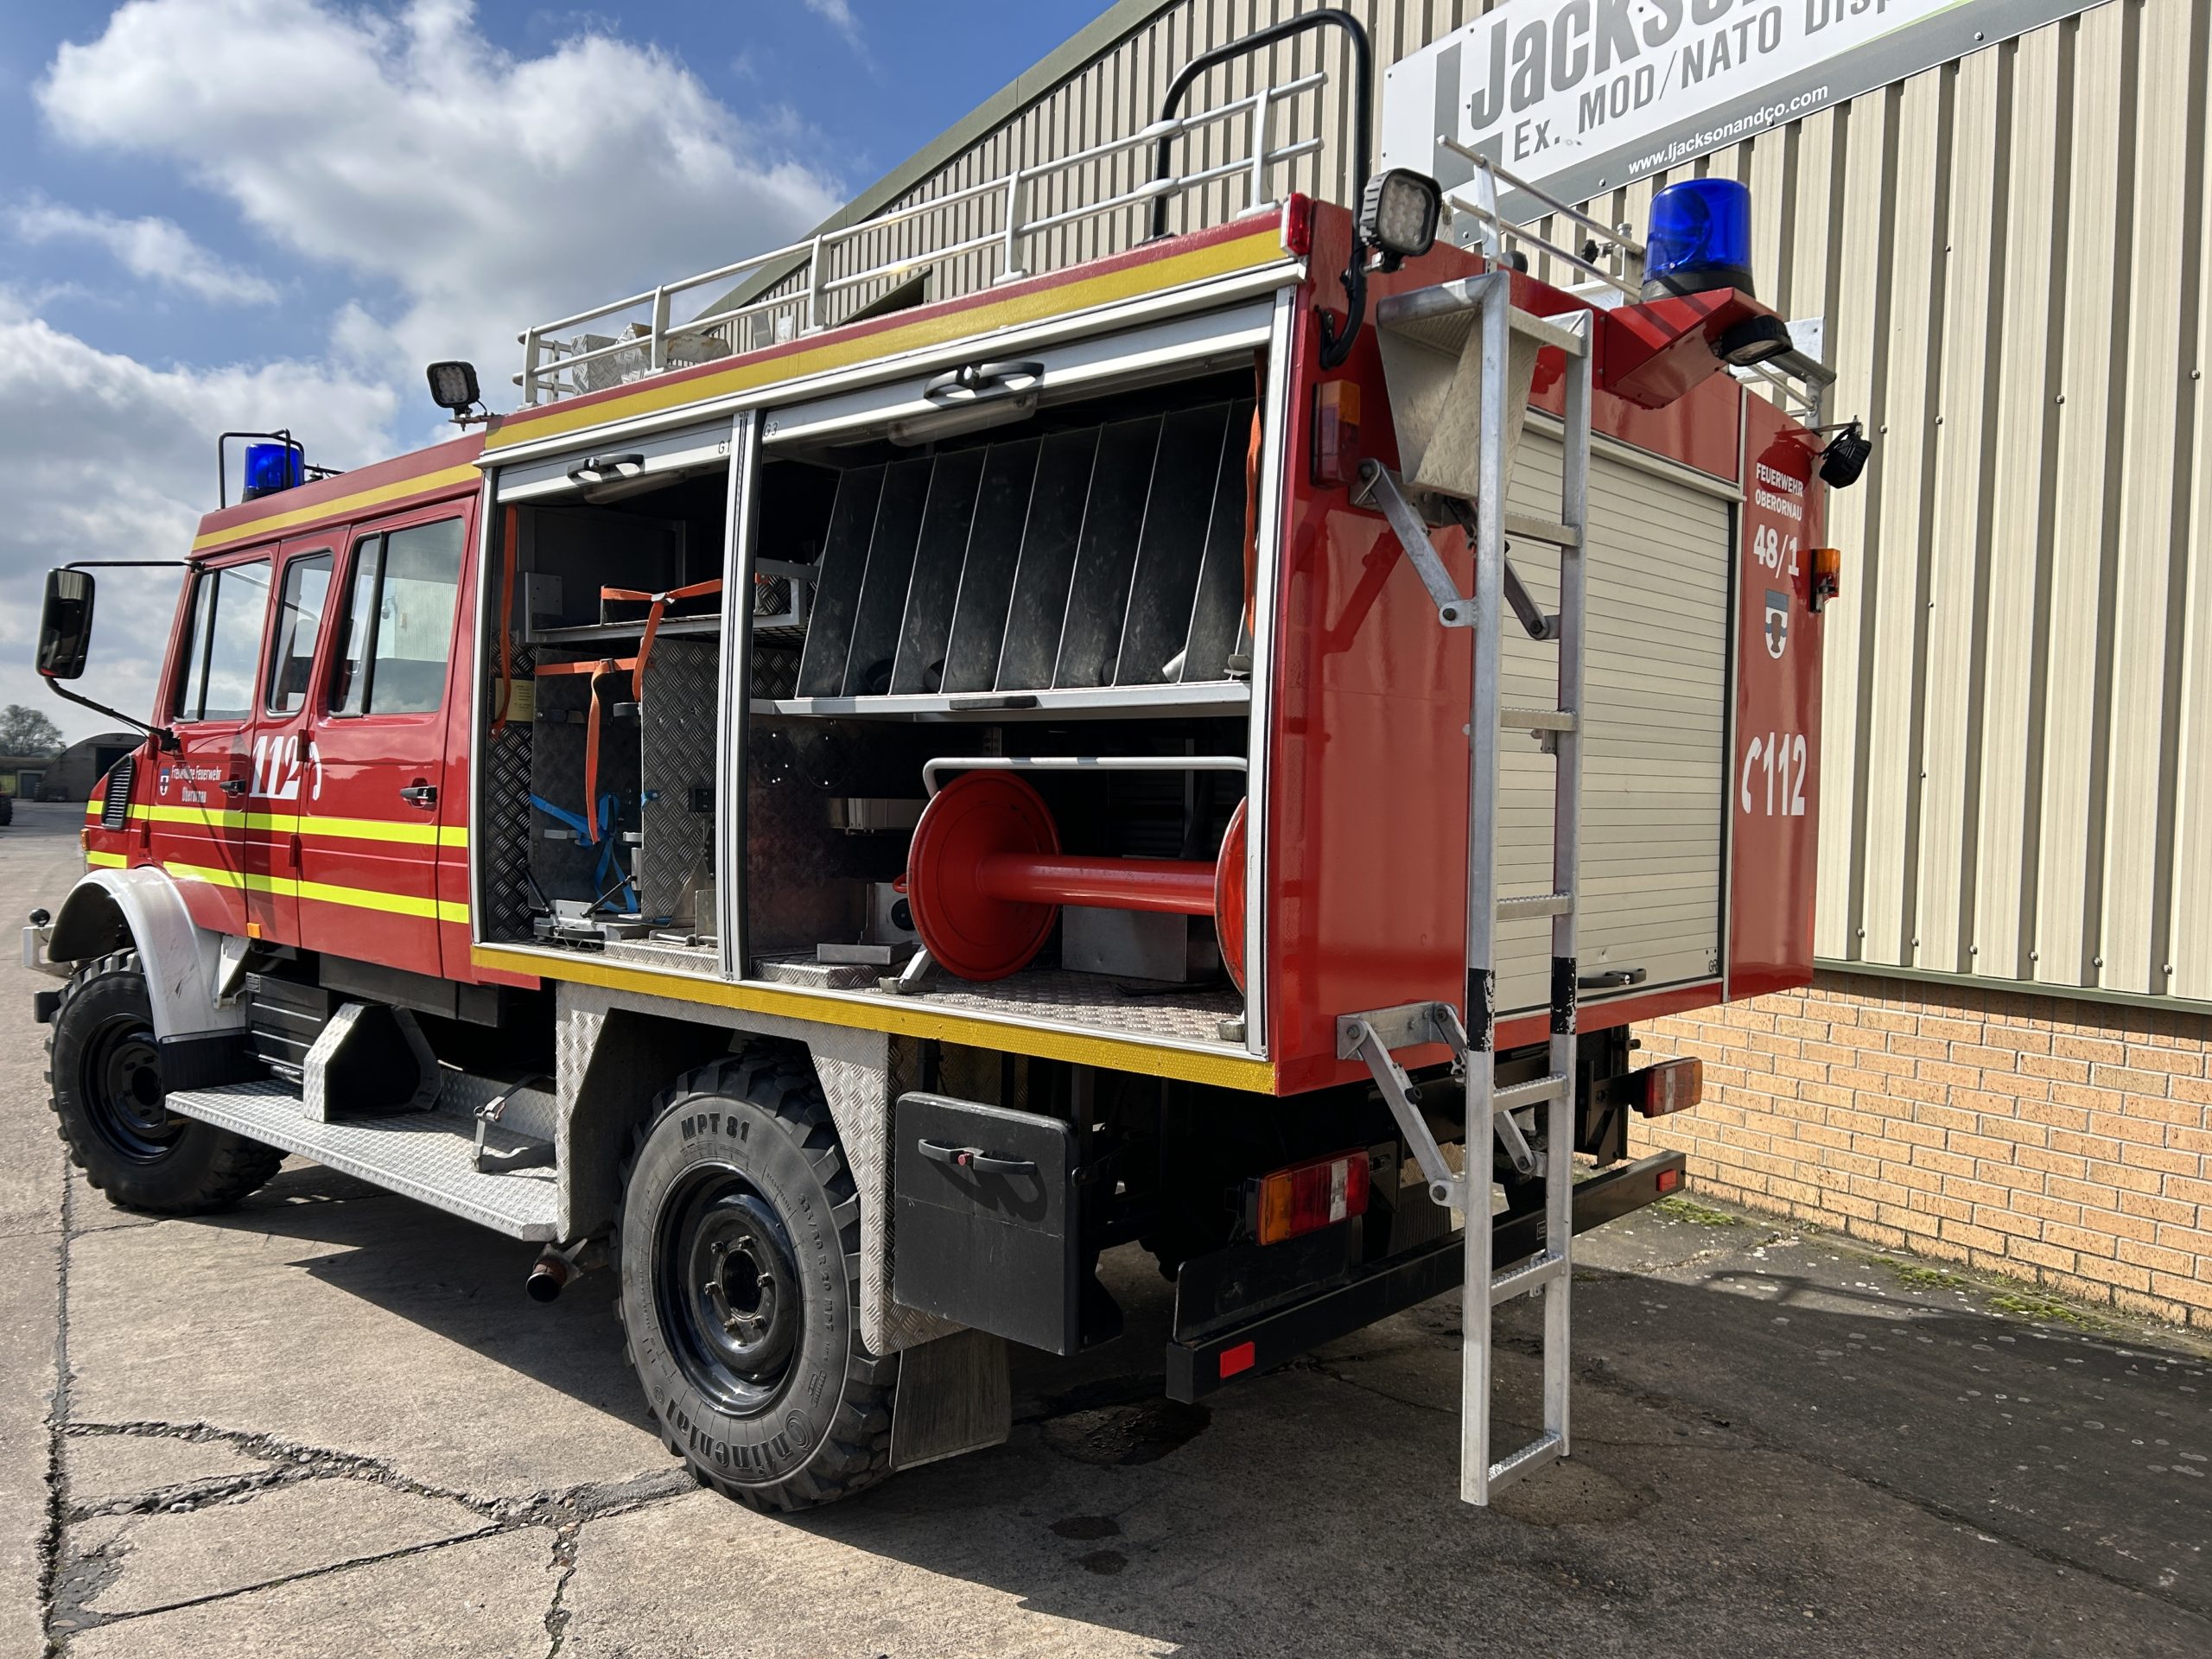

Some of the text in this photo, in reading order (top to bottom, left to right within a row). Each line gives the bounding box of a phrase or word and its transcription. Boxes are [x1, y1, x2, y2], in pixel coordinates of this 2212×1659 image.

[1514, 118, 1560, 162] Ex.
[1579, 5, 1783, 134] MOD/NATO
[1629, 85, 1827, 175] www.ljacksonandco.com
[763, 422, 779, 437] G3
[1755, 488, 1802, 522] OBERORNAU
[1756, 462, 1803, 498] FEUERWEHR
[1753, 524, 1800, 579] 48/1
[248, 734, 302, 800] 112
[1763, 731, 1807, 817] 112
[680, 1111, 750, 1143] MPT 81
